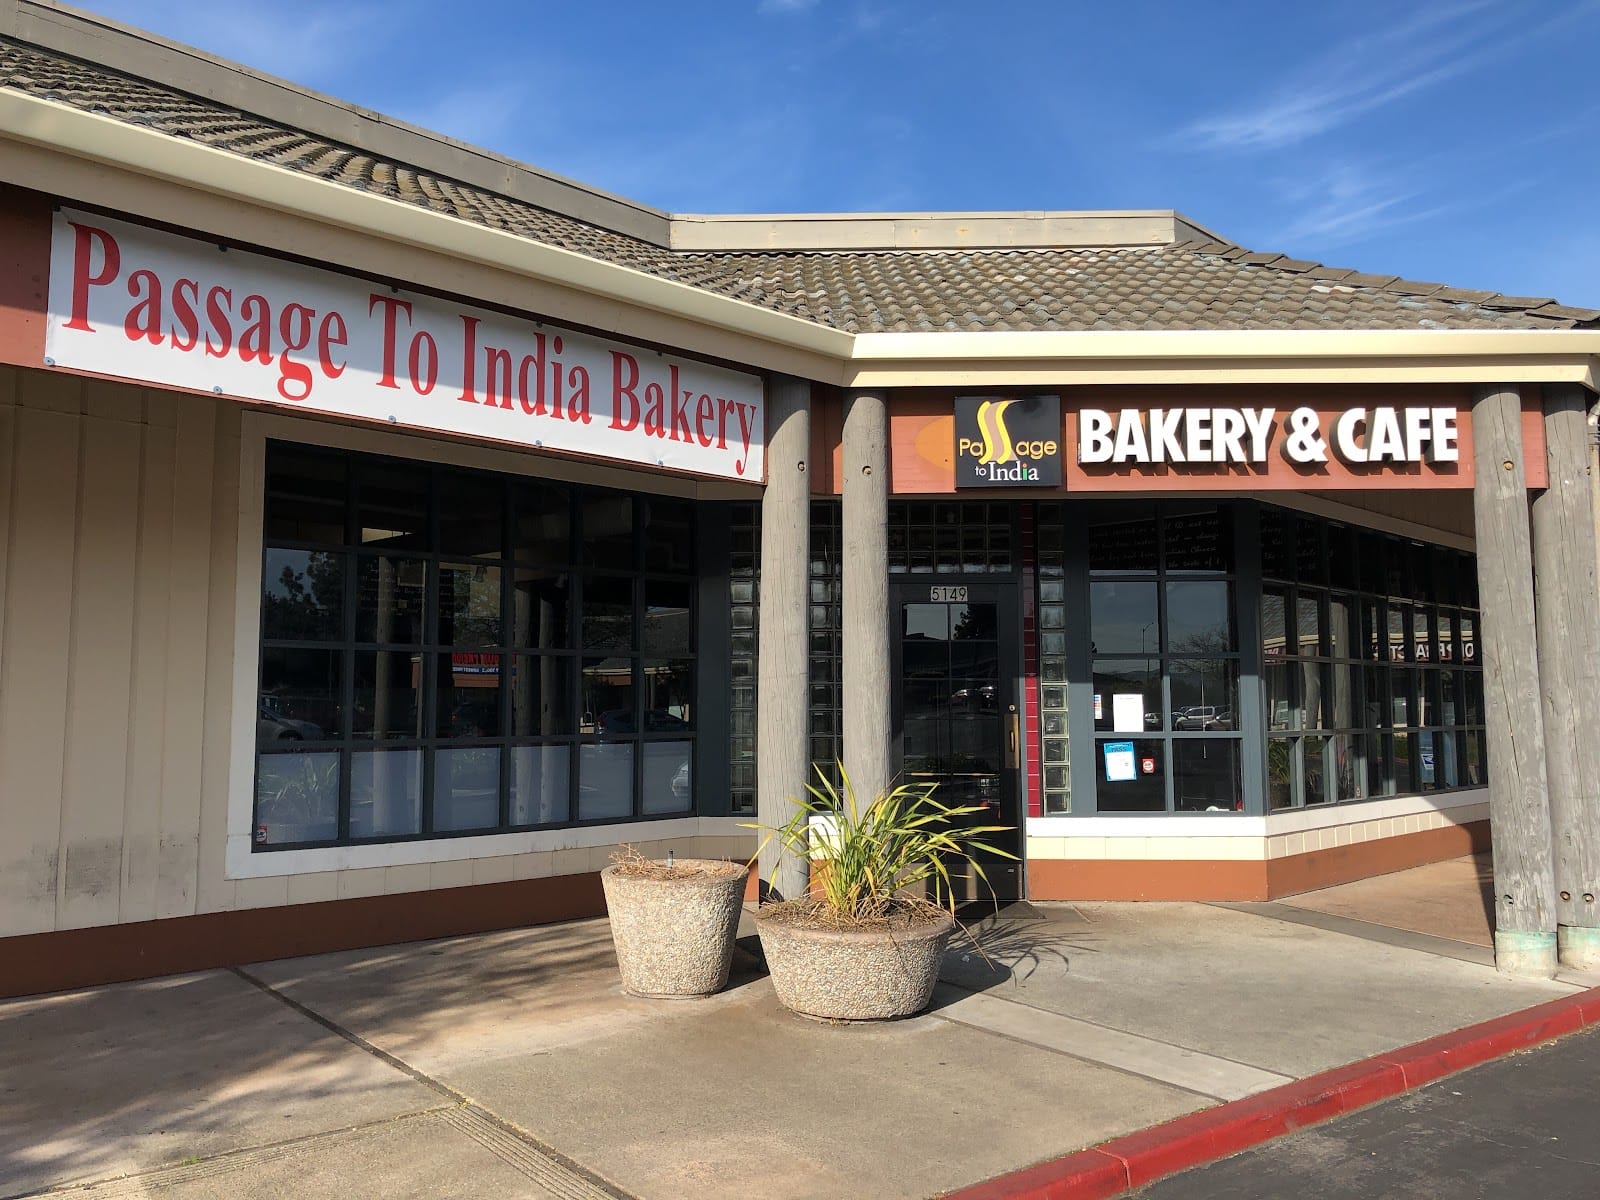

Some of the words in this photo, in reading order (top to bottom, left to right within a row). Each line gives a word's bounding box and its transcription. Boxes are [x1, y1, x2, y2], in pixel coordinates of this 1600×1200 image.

[63, 221, 348, 401] Passage
[369, 293, 439, 396] To
[458, 314, 592, 424] India
[608, 349, 757, 476] Bakery
[1079, 408, 1275, 464] BAKERY
[1286, 406, 1328, 463] &
[1336, 407, 1458, 464] CAFE
[975, 466, 987, 476] to
[988, 460, 1039, 481] India
[931, 587, 967, 601] 5149
